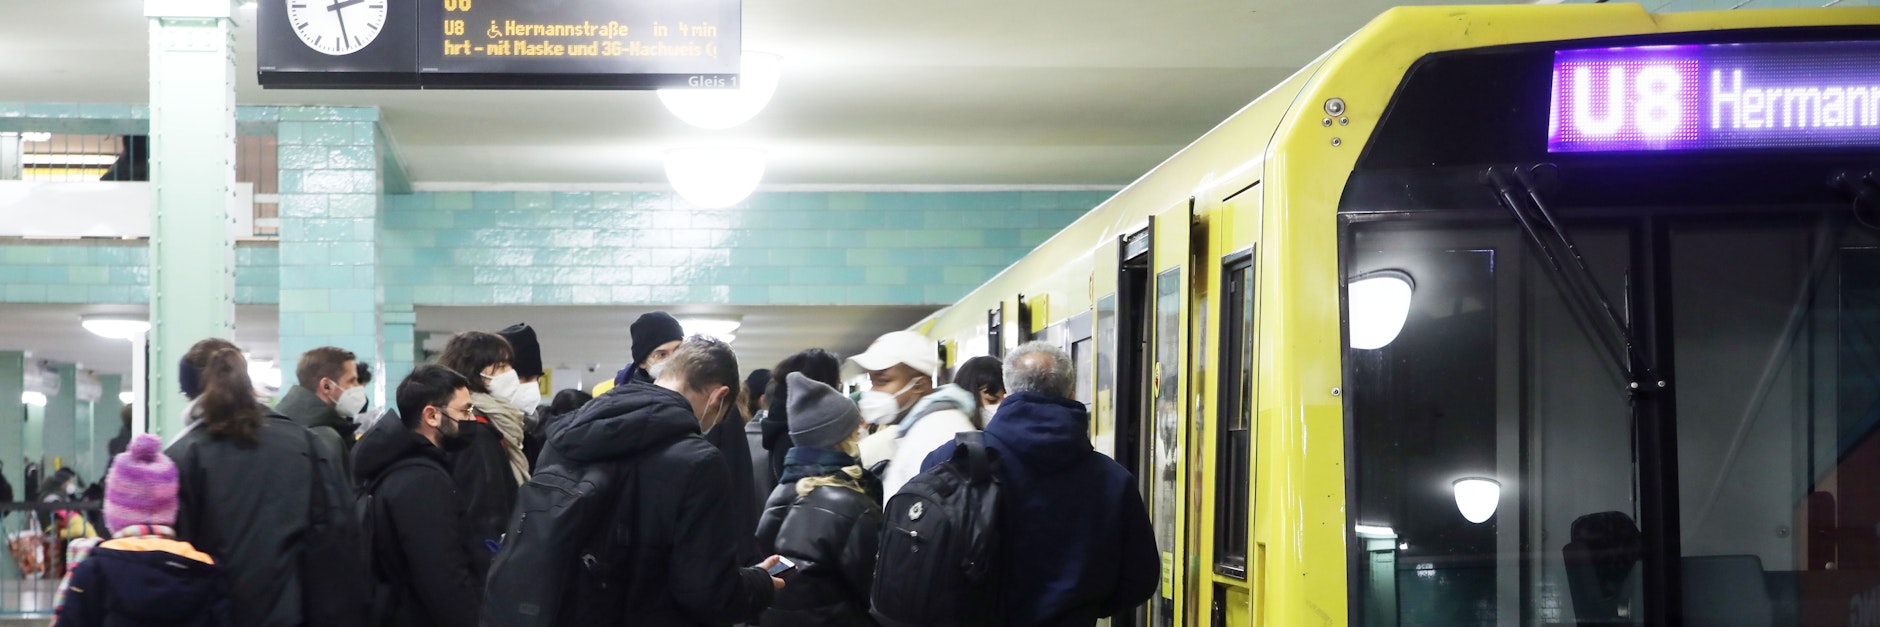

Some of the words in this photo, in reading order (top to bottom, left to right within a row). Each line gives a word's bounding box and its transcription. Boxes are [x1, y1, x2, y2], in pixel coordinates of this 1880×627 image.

[444, 20, 465, 36] U8
[505, 20, 629, 39] Hermannstraße
[653, 21, 668, 37] in
[679, 21, 689, 37] 4
[692, 21, 717, 37] min
[444, 40, 471, 56] hrt
[487, 40, 511, 56] mit
[514, 40, 565, 56] Maske
[568, 40, 598, 56] und
[688, 76, 726, 89] Gleis
[731, 77, 738, 88] 1
[1574, 65, 1682, 136] U8
